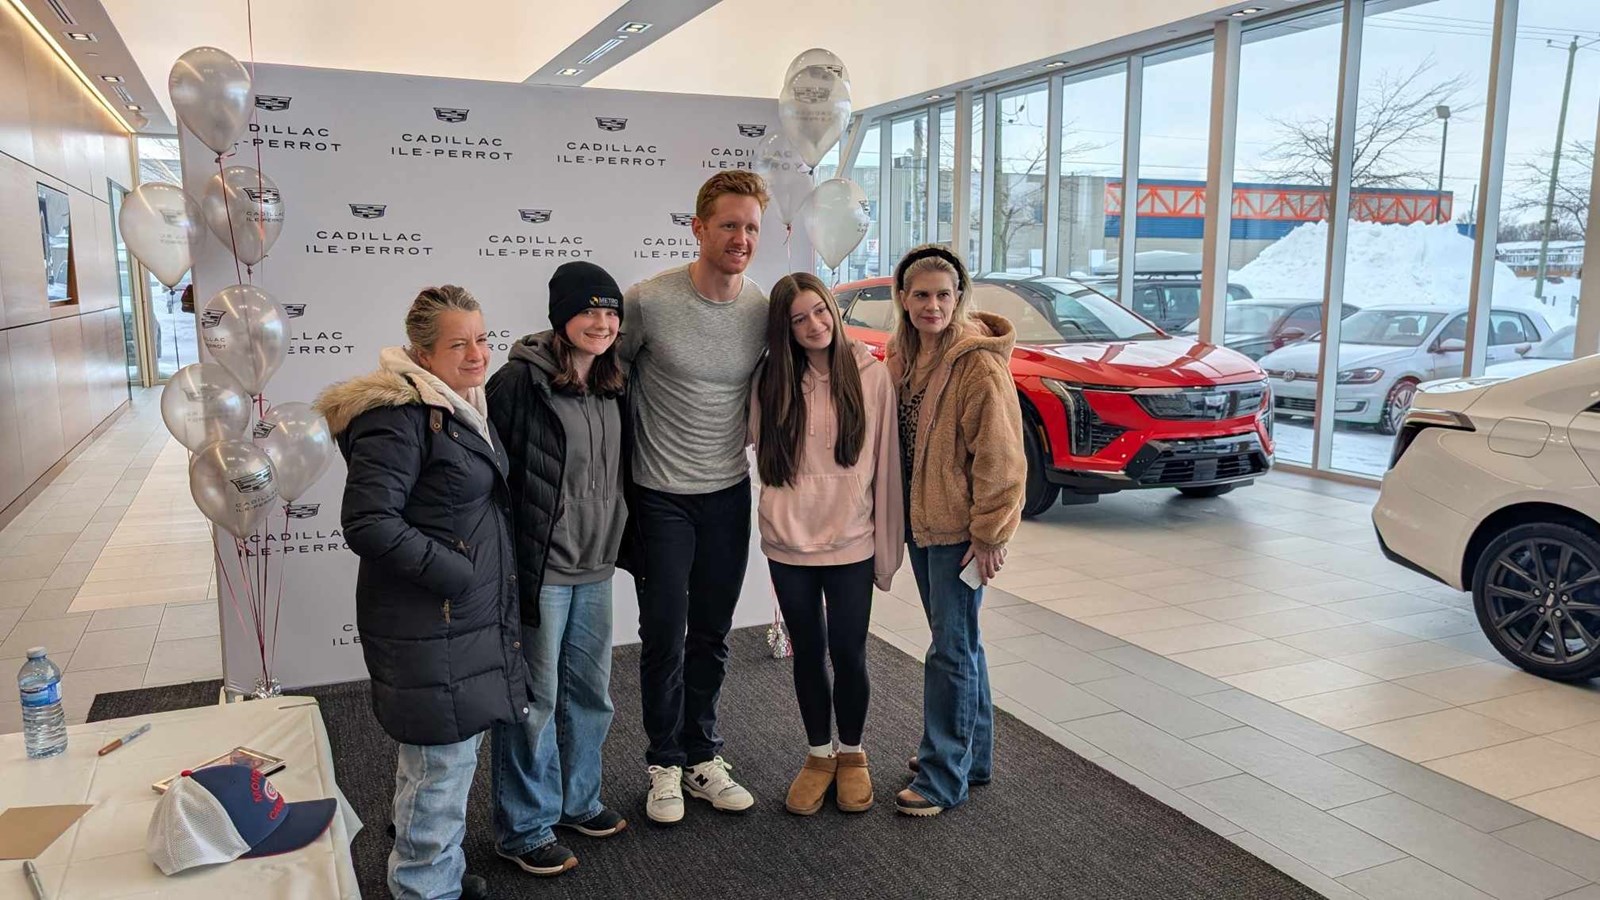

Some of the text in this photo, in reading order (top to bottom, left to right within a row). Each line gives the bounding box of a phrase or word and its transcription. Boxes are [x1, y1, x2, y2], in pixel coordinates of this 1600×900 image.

[249, 123, 329, 137] DILLAC
[234, 138, 341, 152] -PERROT
[402, 133, 502, 146] CADILLAC
[391, 146, 513, 161] ILE-PERROT
[566, 141, 657, 154] CADILLAC
[557, 154, 666, 167] ILE-PERROT
[316, 230, 422, 242] CADILLAC
[488, 235, 583, 245] CADILLAC
[643, 237, 701, 246] CADILL
[306, 244, 433, 255] ILE-PERROT
[478, 248, 593, 257] ILE-PERROT
[634, 250, 700, 259] ILE-PER
[599, 297, 619, 305] METRO
[287, 345, 354, 355] ERROT
[250, 529, 341, 542] CADILLA
[239, 543, 351, 557] ILE-PERRO
